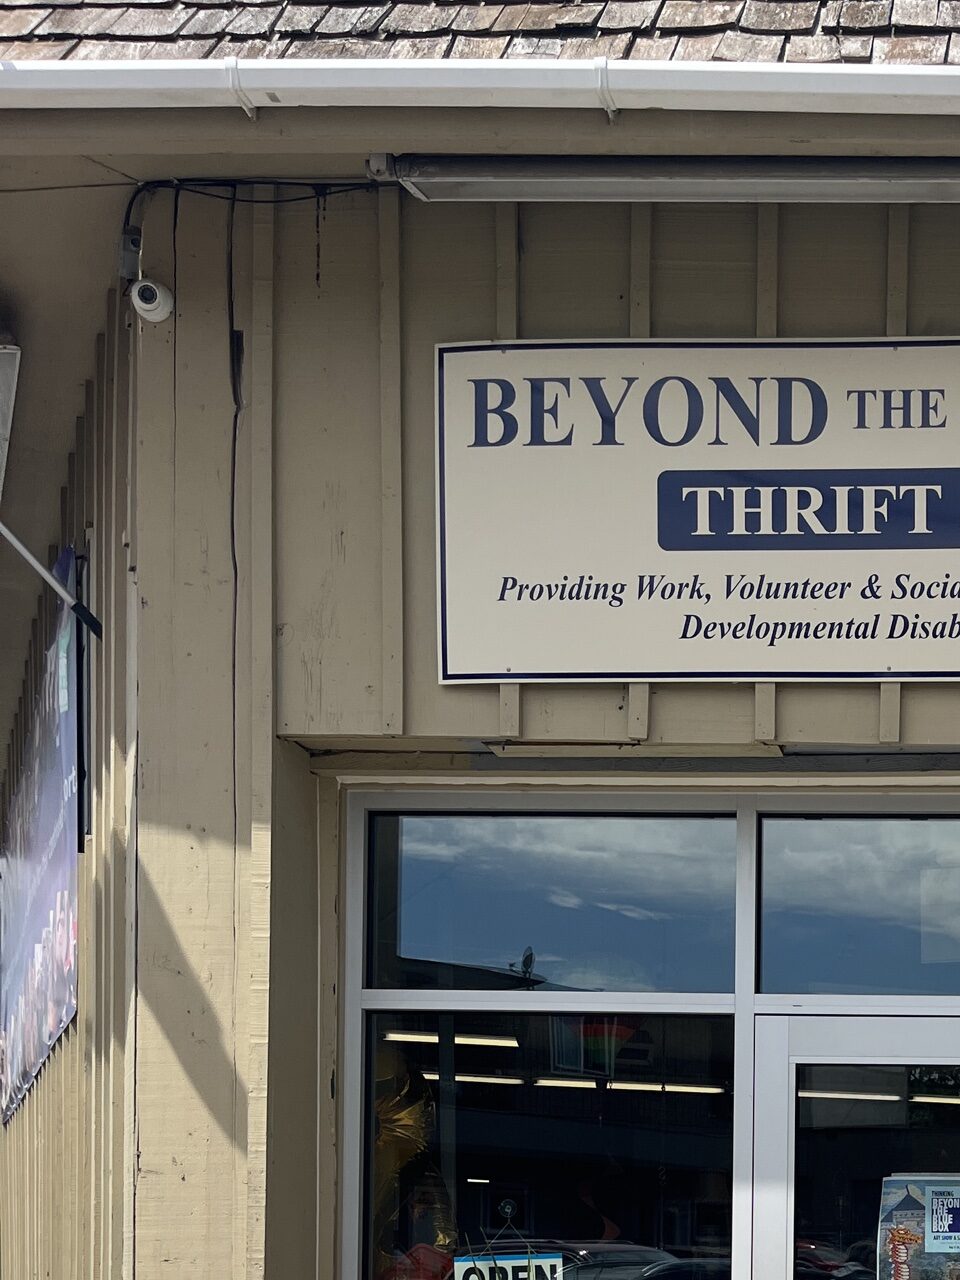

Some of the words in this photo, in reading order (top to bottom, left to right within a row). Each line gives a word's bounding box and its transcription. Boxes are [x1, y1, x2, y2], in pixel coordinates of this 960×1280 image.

[467, 375, 828, 448] BEYOND
[847, 388, 948, 430] THE
[682, 485, 942, 537] THRIFT
[497, 576, 626, 603] Providing
[637, 575, 712, 604] Work,
[724, 574, 852, 600] Volunteer
[860, 574, 882, 600] &
[678, 612, 879, 647] Developmental
[932, 1207, 949, 1215] THE
[932, 1214, 954, 1224] BLUE
[932, 1222, 950, 1232] BOX
